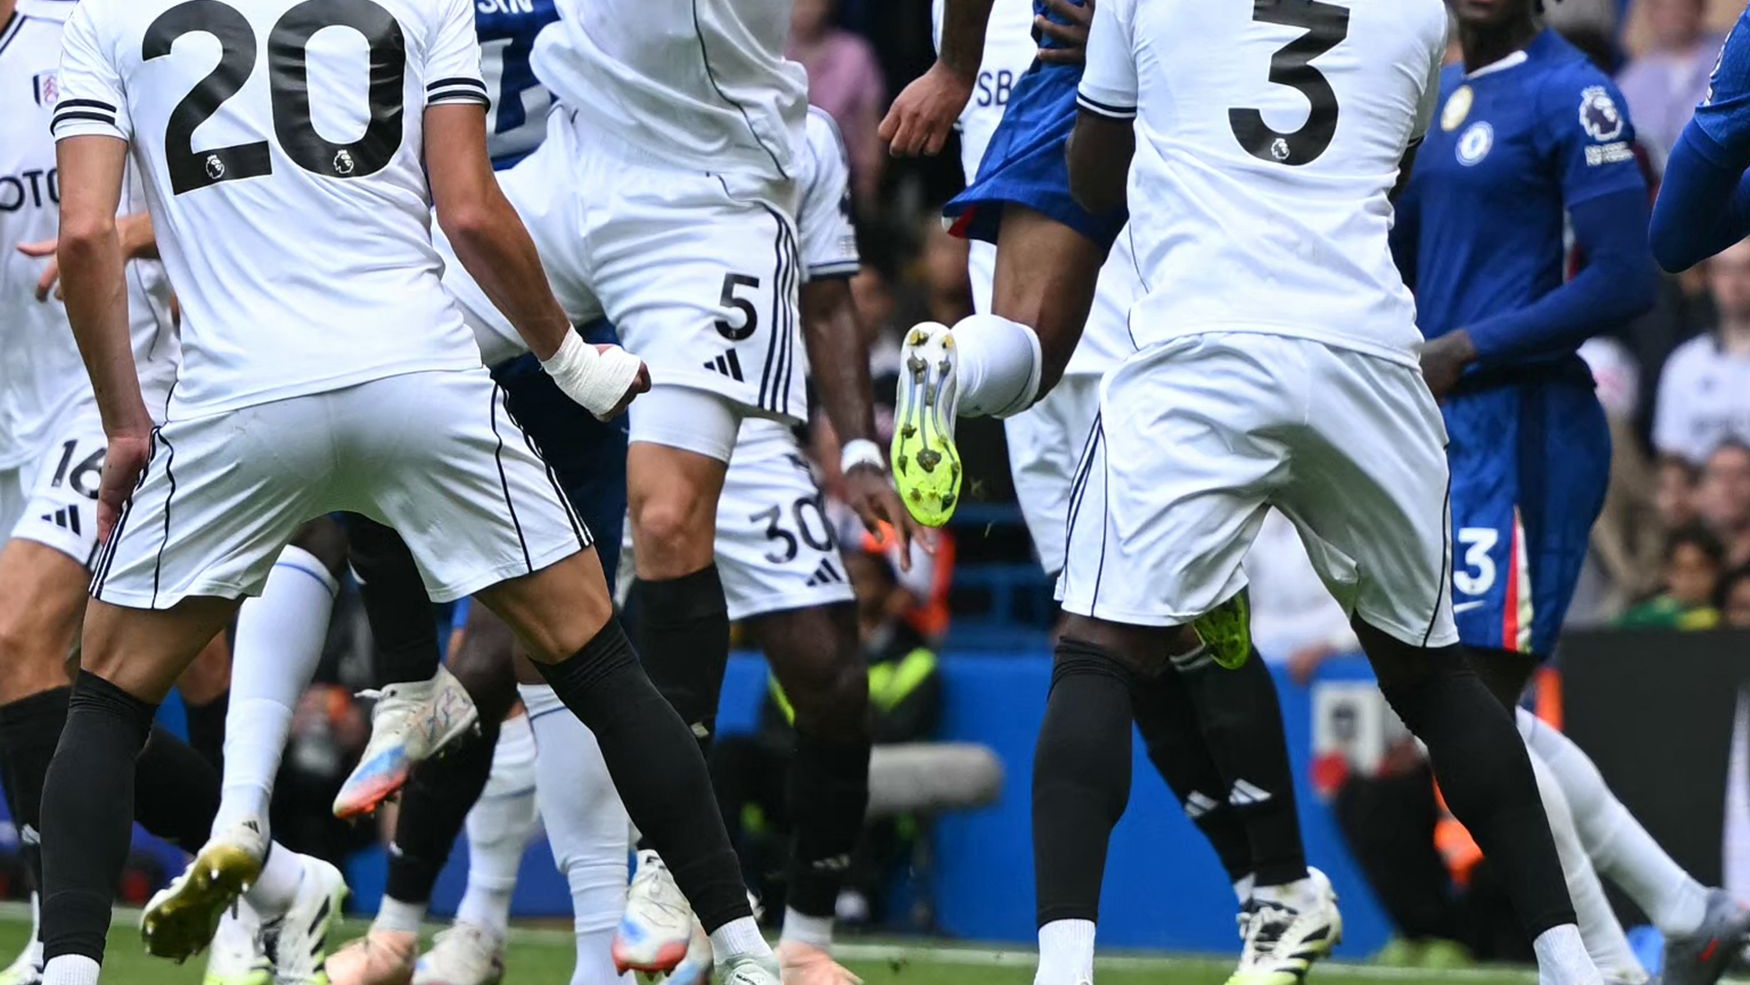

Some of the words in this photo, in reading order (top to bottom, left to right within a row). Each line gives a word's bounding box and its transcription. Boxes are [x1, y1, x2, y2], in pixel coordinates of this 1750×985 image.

[714, 272, 760, 342] 5
[51, 438, 107, 500] 16
[749, 496, 837, 564] 30
[1453, 527, 1499, 596] 3
